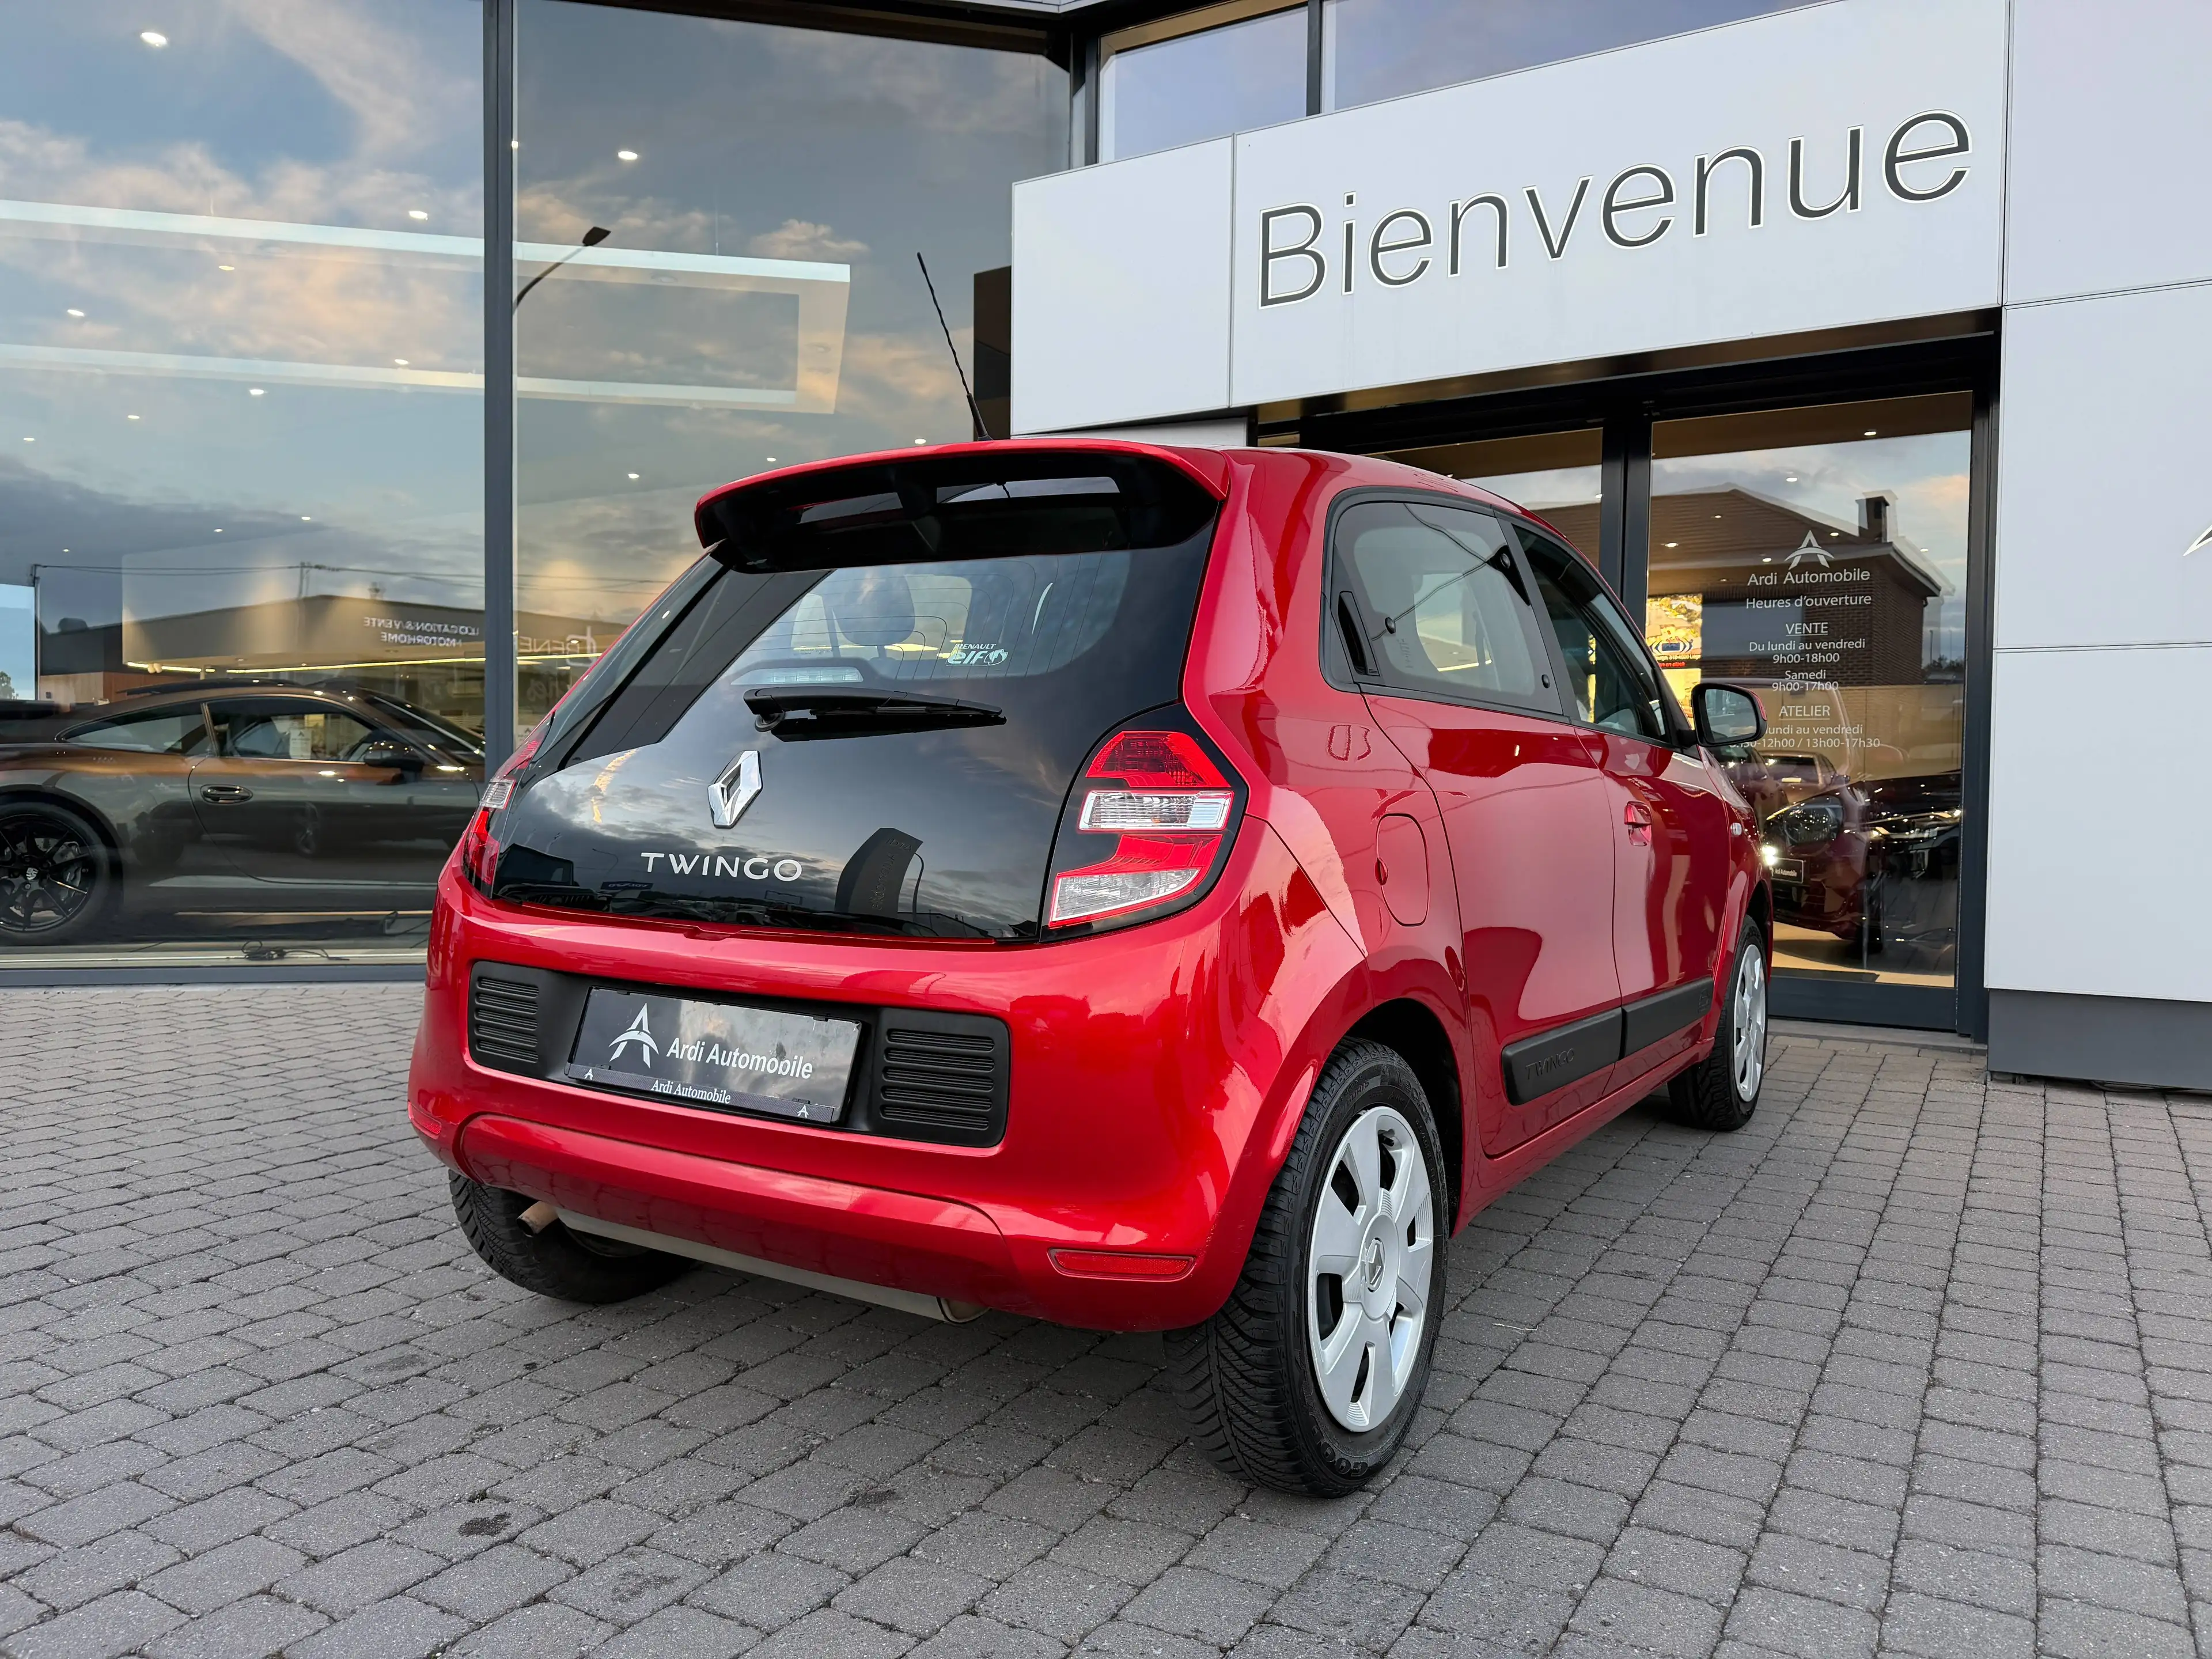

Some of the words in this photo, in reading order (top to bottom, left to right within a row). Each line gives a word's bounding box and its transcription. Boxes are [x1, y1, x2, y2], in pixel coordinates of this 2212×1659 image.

[1258, 109, 1973, 309] Bienvenue
[1747, 572, 1777, 586] Ardi
[1783, 568, 1870, 584] Automobile
[1746, 598, 1791, 609] Heures
[1794, 594, 1872, 607] d'ouverture
[1786, 622, 1828, 634] VENTE
[1749, 642, 1764, 652] Du
[1768, 641, 1796, 650] lundi
[1798, 642, 1812, 650] au
[1815, 638, 1865, 649] vendredi
[1772, 653, 1840, 664] 9h00-18h00
[1785, 669, 1826, 680] Samedi
[1772, 681, 1839, 691] 9h00-17h00
[1779, 705, 1831, 717] ATELIER
[1813, 724, 1863, 734] vendredi
[1806, 738, 1881, 748] 13h00-17h30
[640, 852, 802, 882] TWINGO
[666, 1037, 706, 1062] Ardi
[706, 1043, 813, 1080] Automobile
[1525, 1048, 1574, 1080] TWINGO
[650, 1079, 673, 1093] Ardi
[674, 1082, 731, 1104] Automobile
